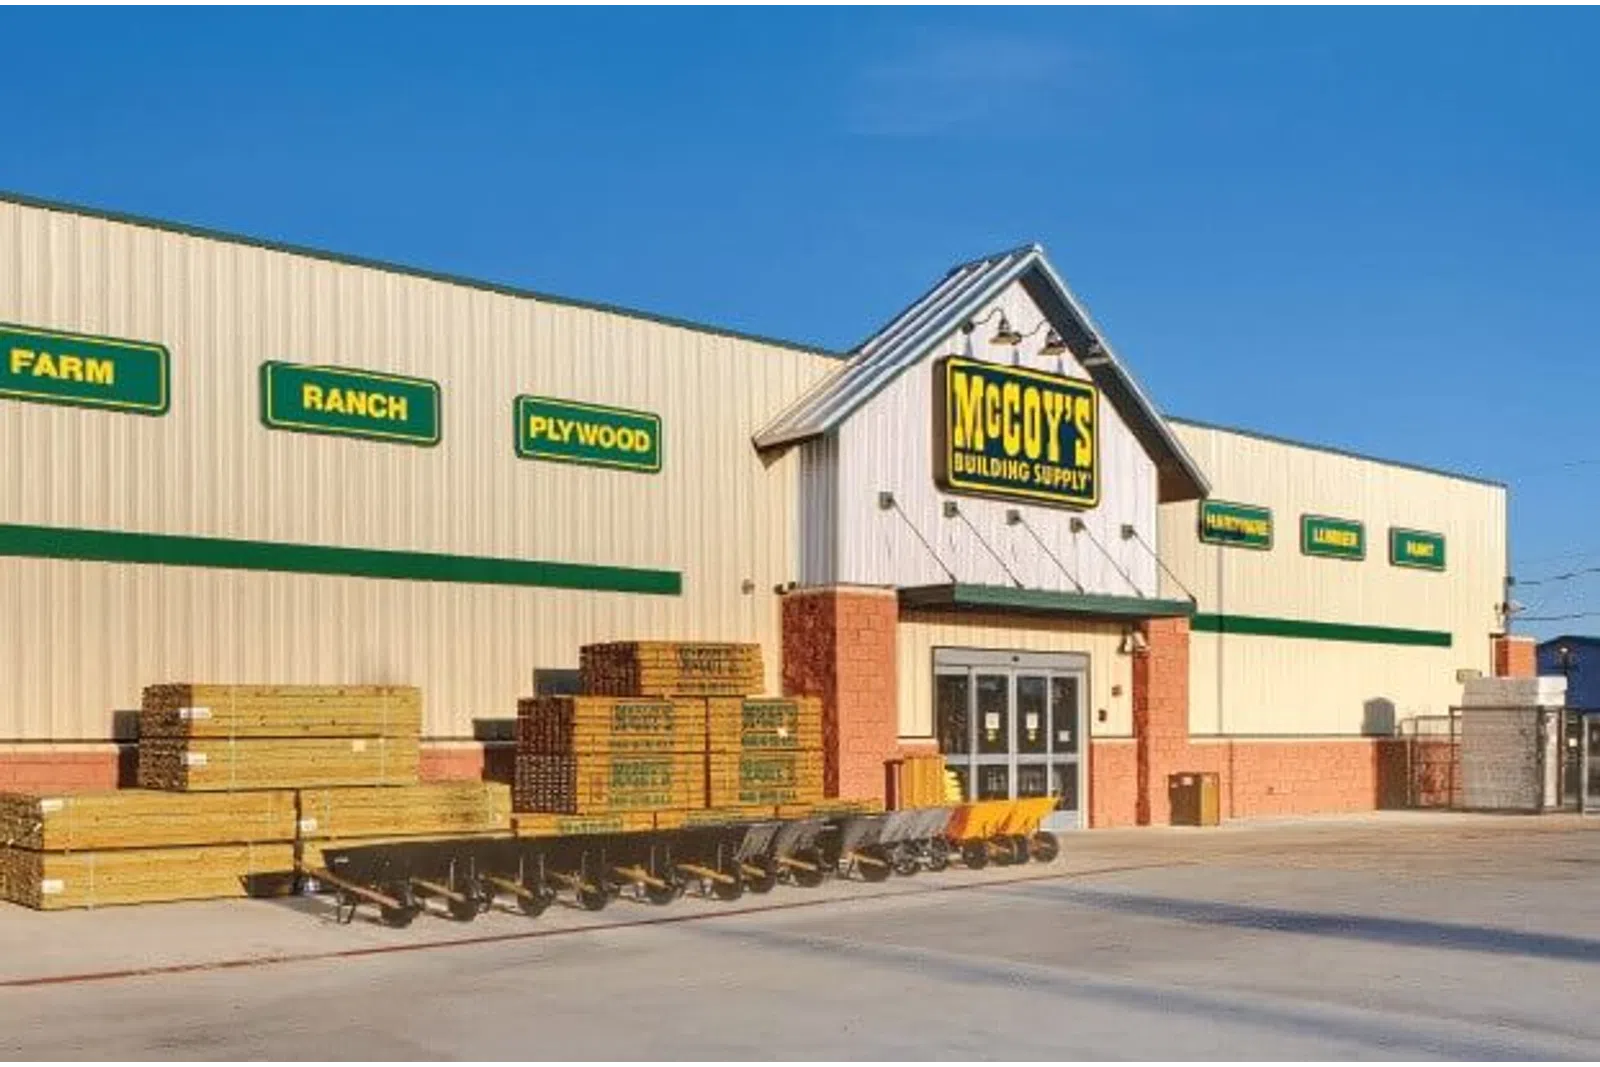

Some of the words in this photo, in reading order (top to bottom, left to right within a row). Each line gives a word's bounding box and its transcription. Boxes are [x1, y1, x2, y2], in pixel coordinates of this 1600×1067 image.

[10, 348, 115, 385] FARM
[302, 382, 408, 421] RANCH
[529, 414, 651, 453] PLYWOOD
[953, 452, 1031, 481] BUILDING
